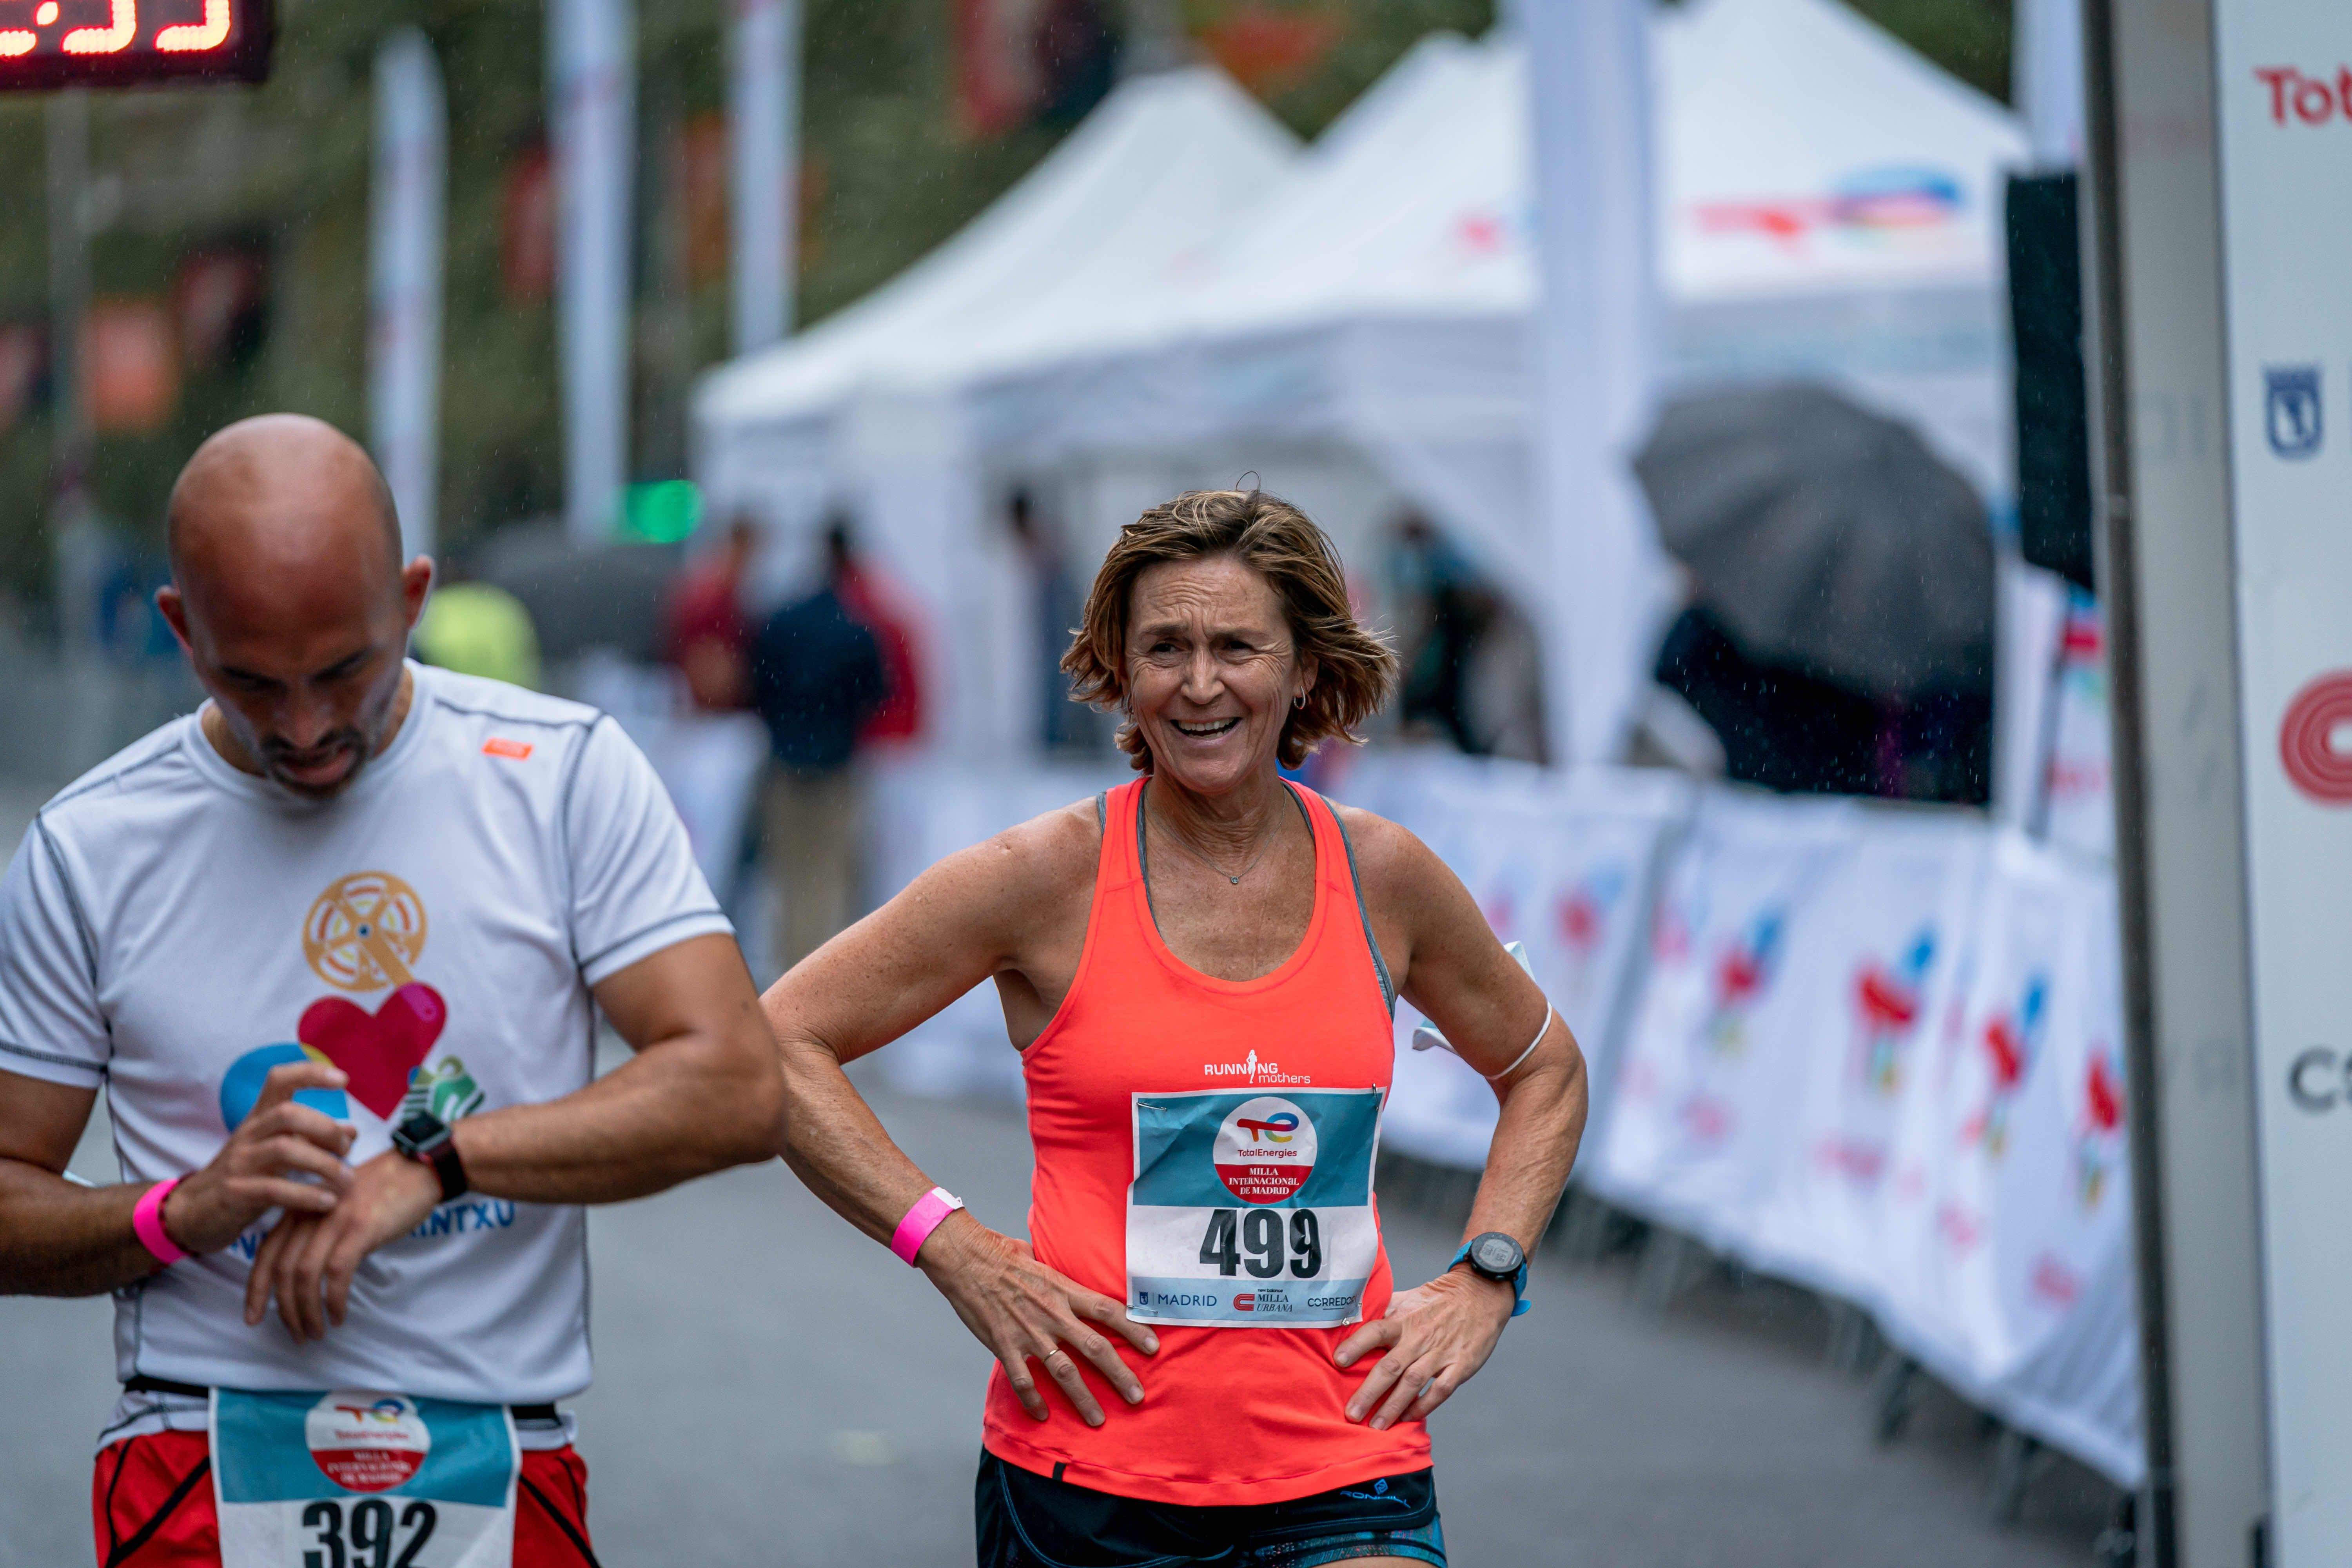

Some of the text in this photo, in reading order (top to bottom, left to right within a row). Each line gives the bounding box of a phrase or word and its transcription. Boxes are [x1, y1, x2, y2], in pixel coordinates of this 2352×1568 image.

[1258, 1073, 1310, 1083] mothers
[1238, 1149, 1297, 1158] TotalEnergies
[1200, 1208, 1322, 1278] 499
[1158, 1294, 1217, 1306] MADRID
[1257, 1303, 1292, 1312] URBANA
[303, 1499, 437, 1568] 392
